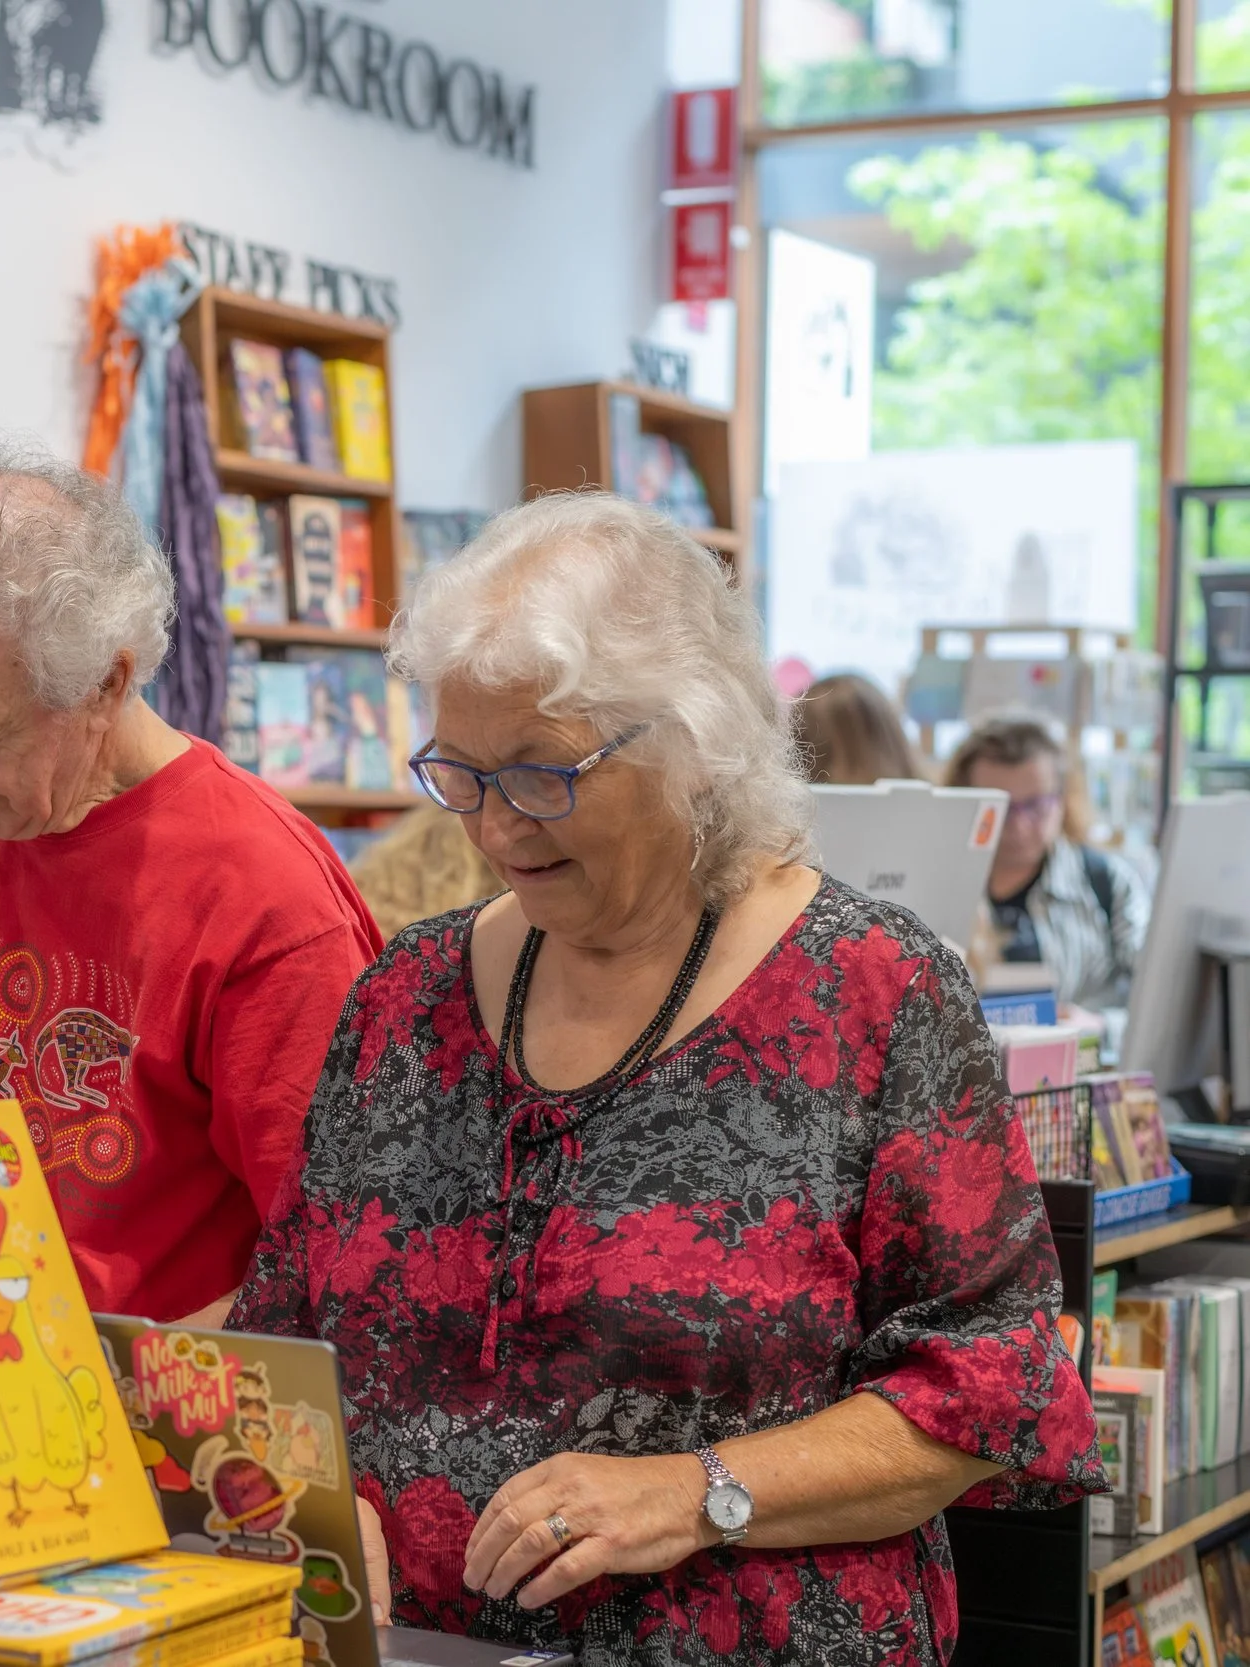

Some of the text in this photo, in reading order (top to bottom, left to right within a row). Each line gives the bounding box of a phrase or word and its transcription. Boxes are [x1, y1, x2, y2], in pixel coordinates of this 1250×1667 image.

[140, 1338, 173, 1377] No
[142, 1363, 198, 1412] Milk
[180, 1392, 218, 1429] My
